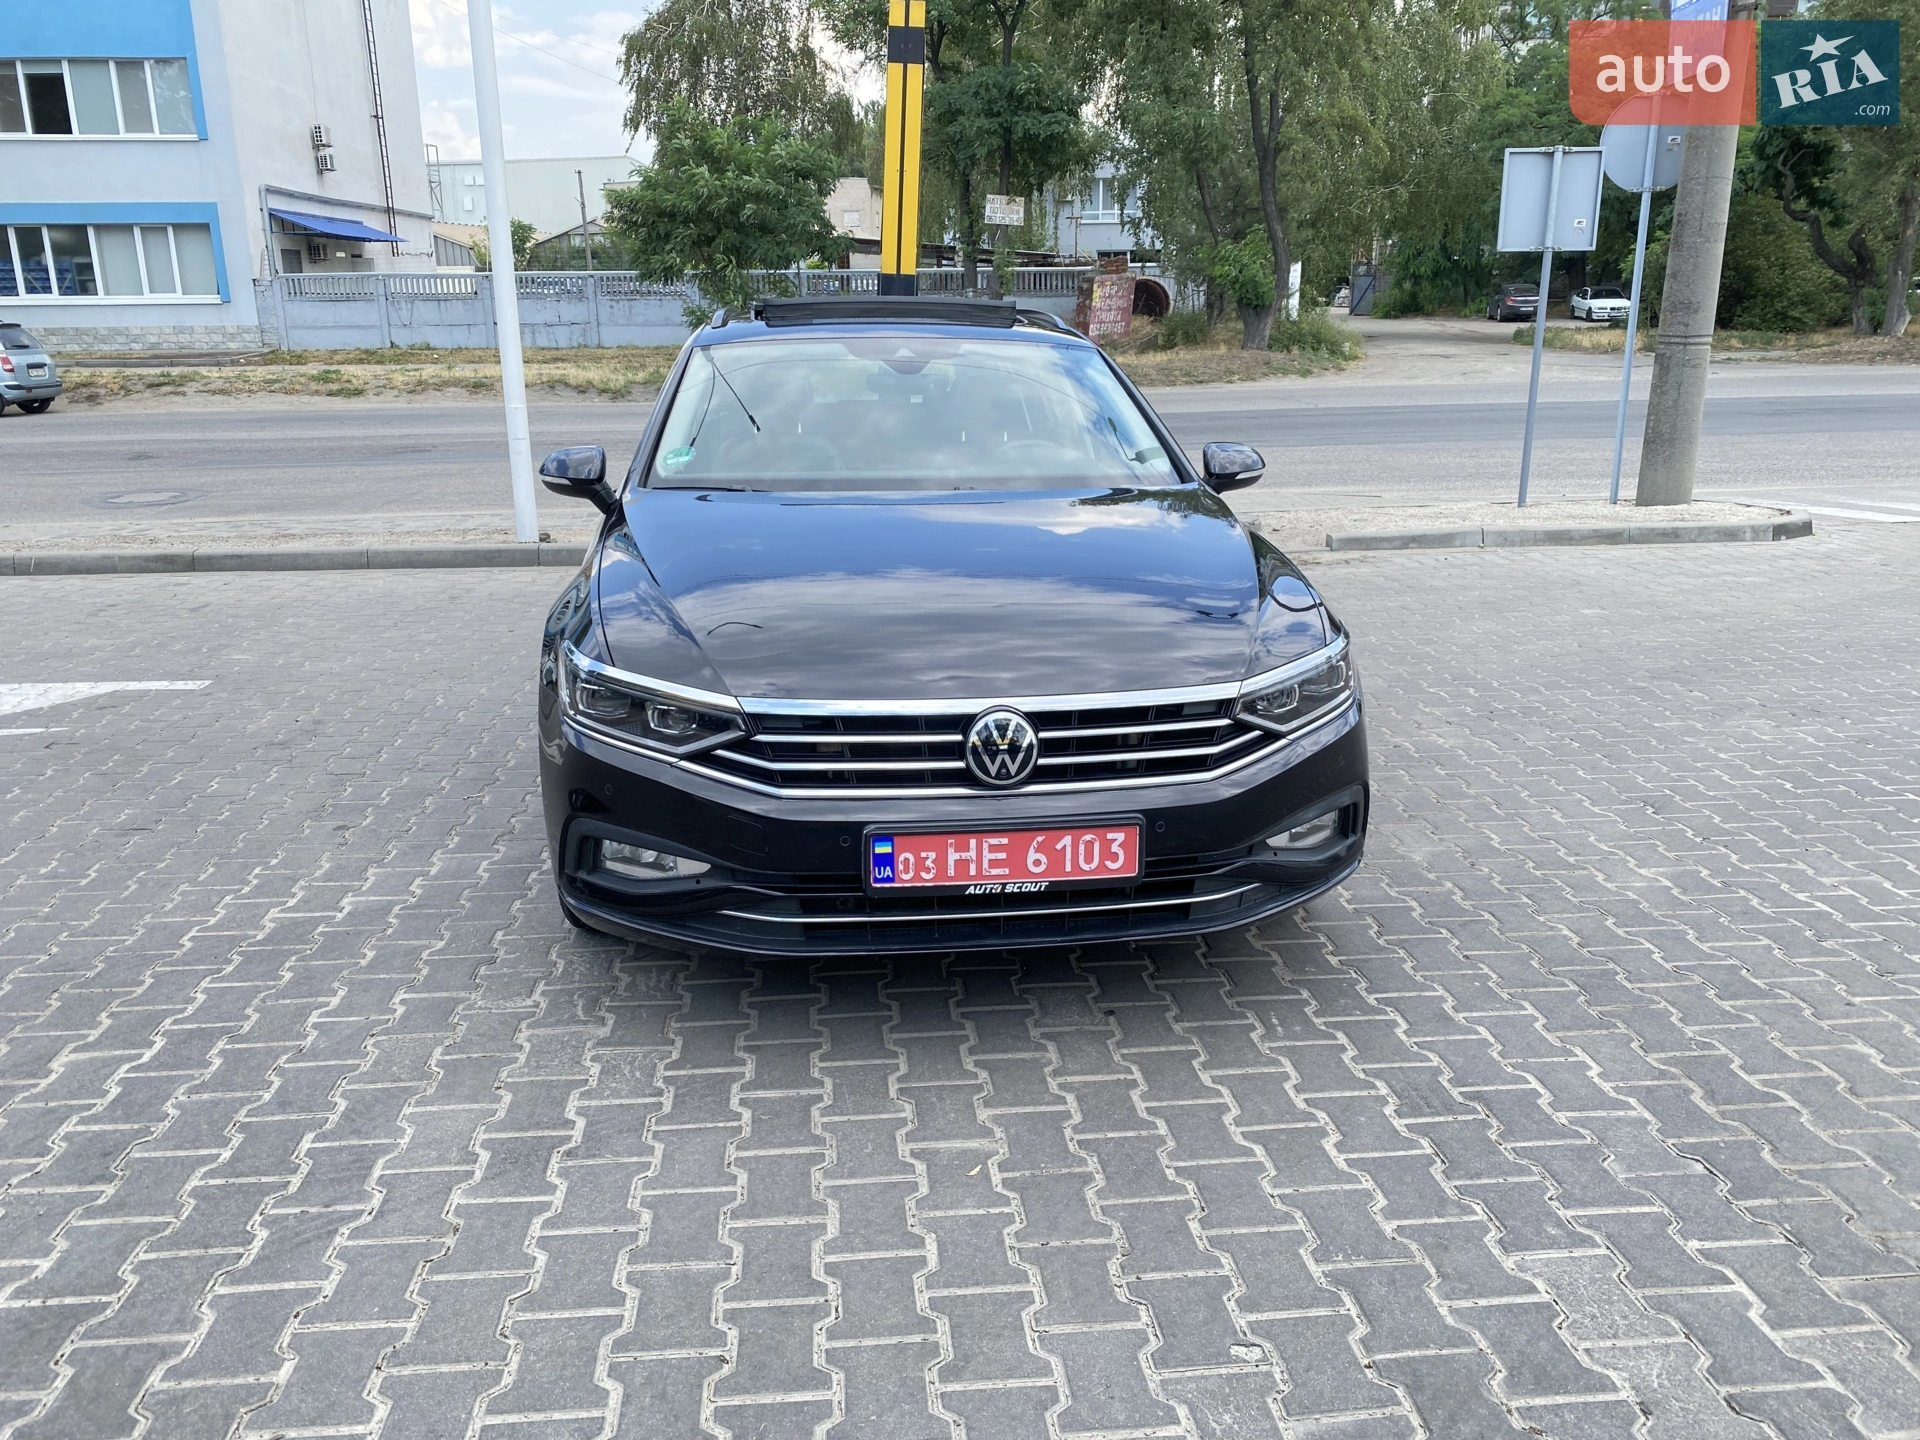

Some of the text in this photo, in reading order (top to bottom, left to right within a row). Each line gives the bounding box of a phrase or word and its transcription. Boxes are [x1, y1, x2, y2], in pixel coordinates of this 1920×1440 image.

[898, 832, 1126, 881] 03 HE 6103
[875, 867, 893, 879] UA
[1005, 882, 1049, 893] SCOUT
